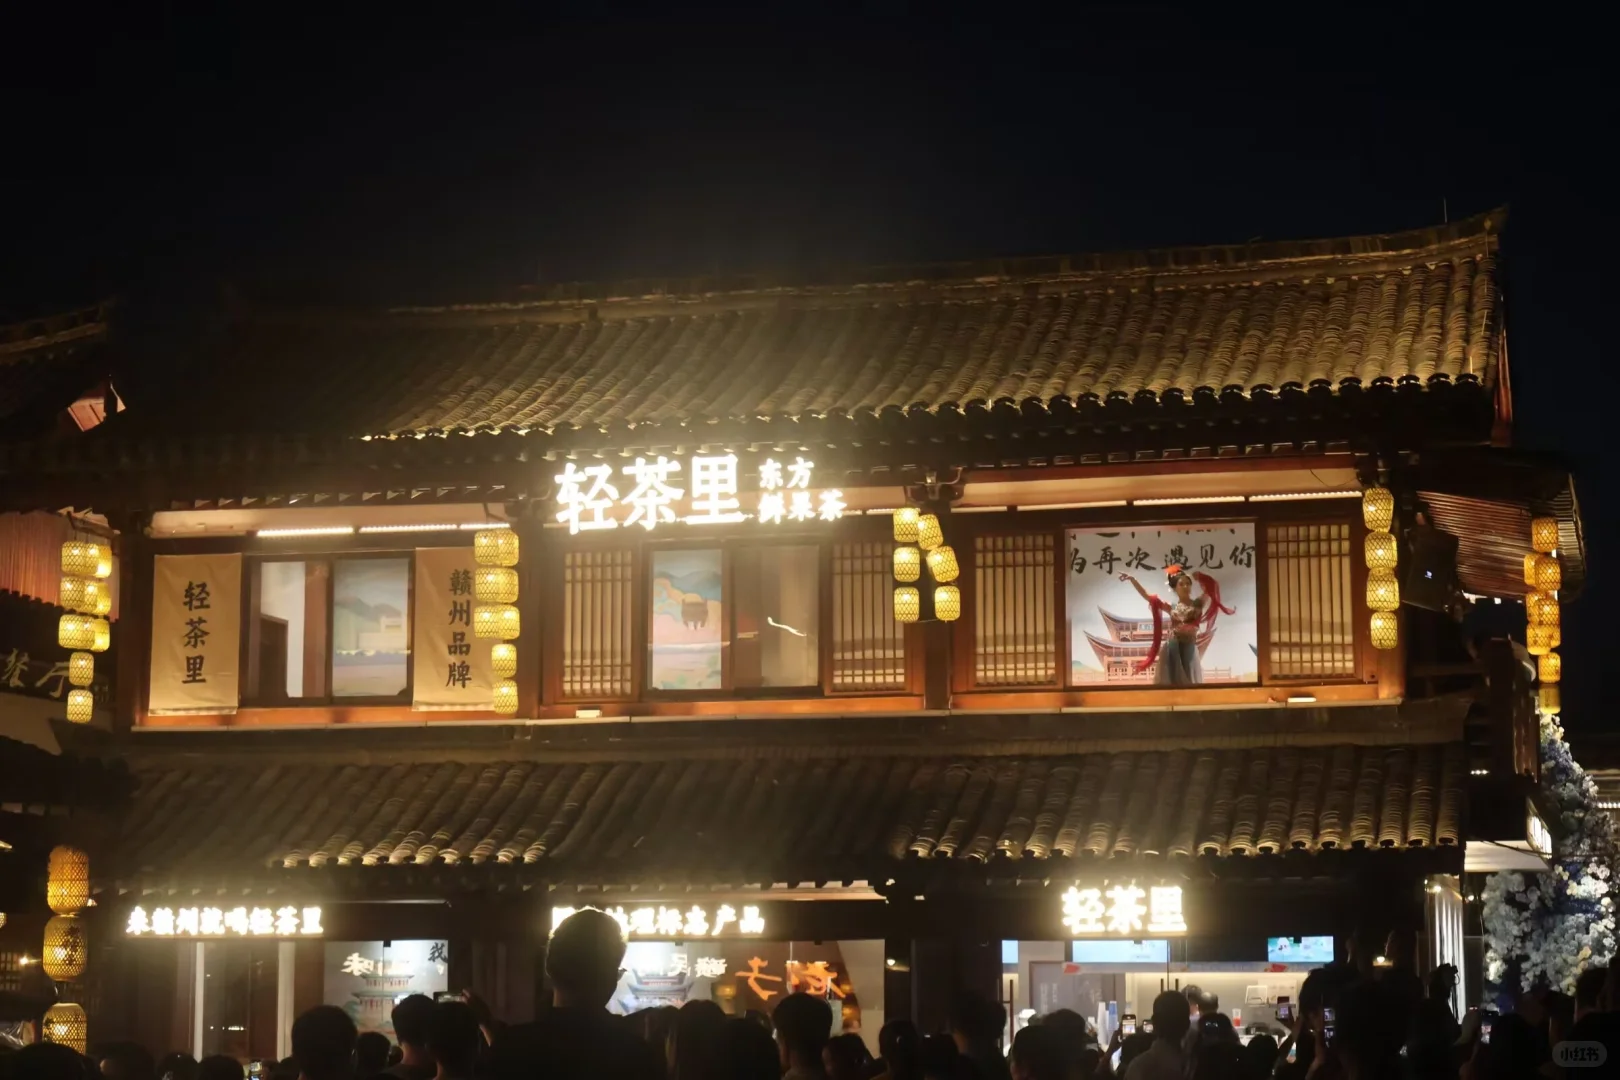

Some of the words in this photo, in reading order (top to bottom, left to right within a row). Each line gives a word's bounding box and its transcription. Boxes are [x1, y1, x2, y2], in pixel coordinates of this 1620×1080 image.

[554, 453, 746, 535] 轻茶里
[759, 456, 815, 490] 东方
[758, 490, 848, 525] 鲜果茶
[181, 580, 211, 685] 轻茶里
[445, 568, 475, 689] 赣州品牌
[1061, 884, 1188, 936] 轻茶里
